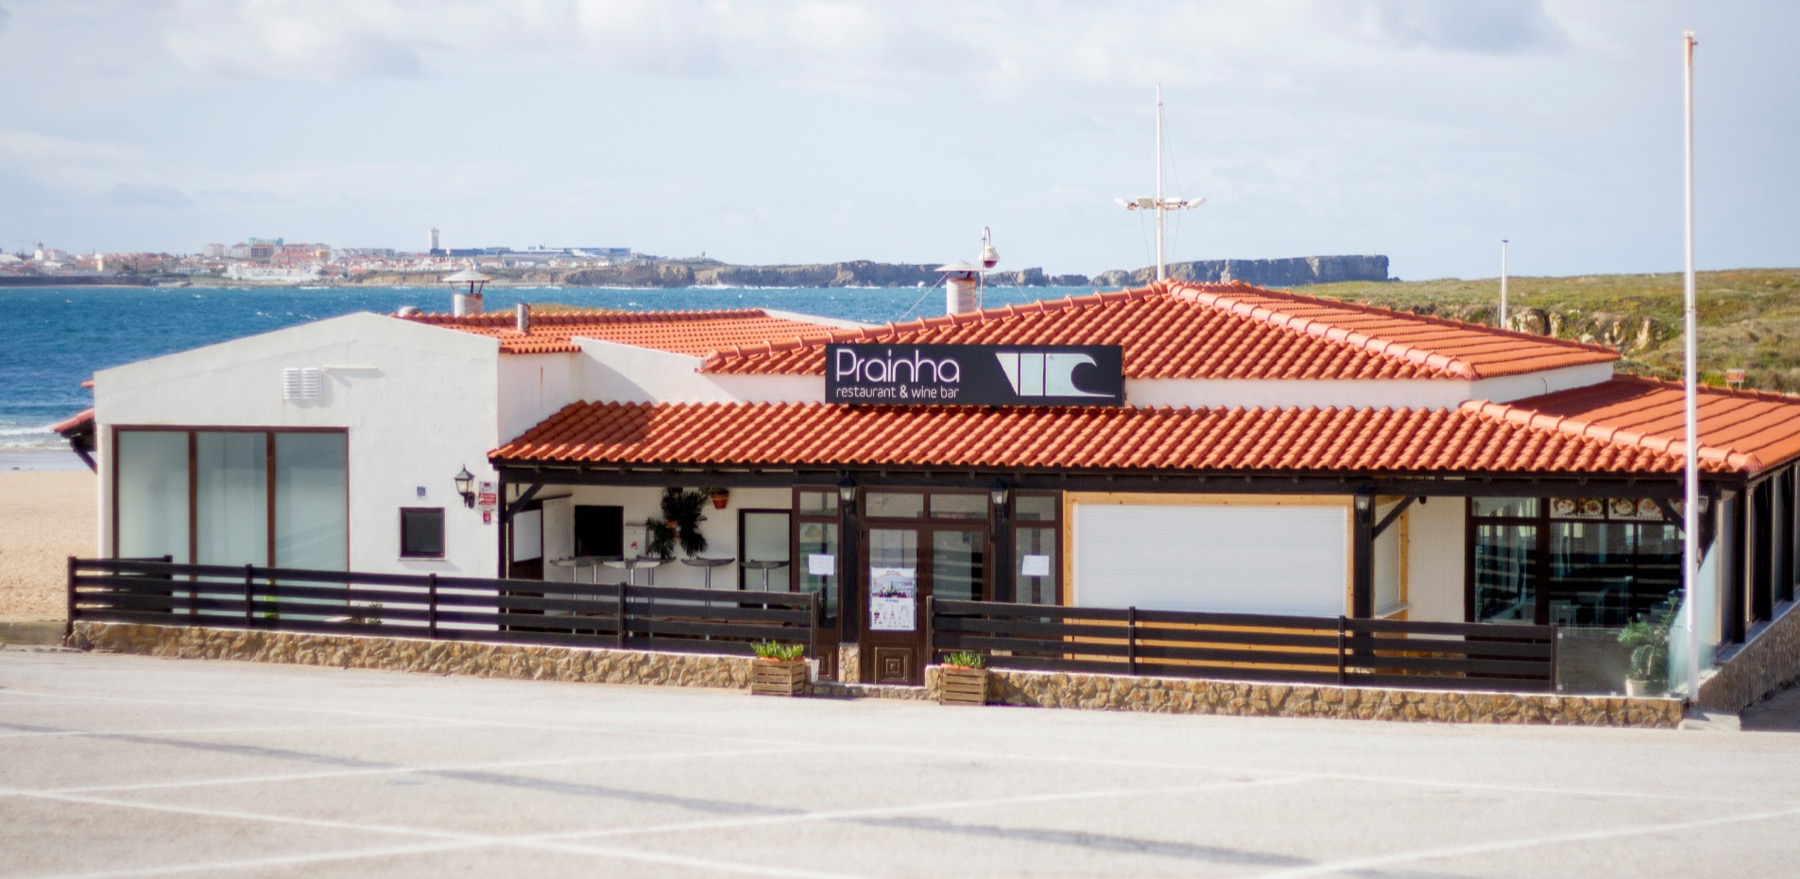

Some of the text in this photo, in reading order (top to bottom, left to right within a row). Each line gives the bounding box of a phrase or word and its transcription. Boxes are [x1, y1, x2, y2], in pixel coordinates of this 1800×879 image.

[836, 348, 960, 383] Prainha
[836, 384, 959, 399] restaurant & wine bar
